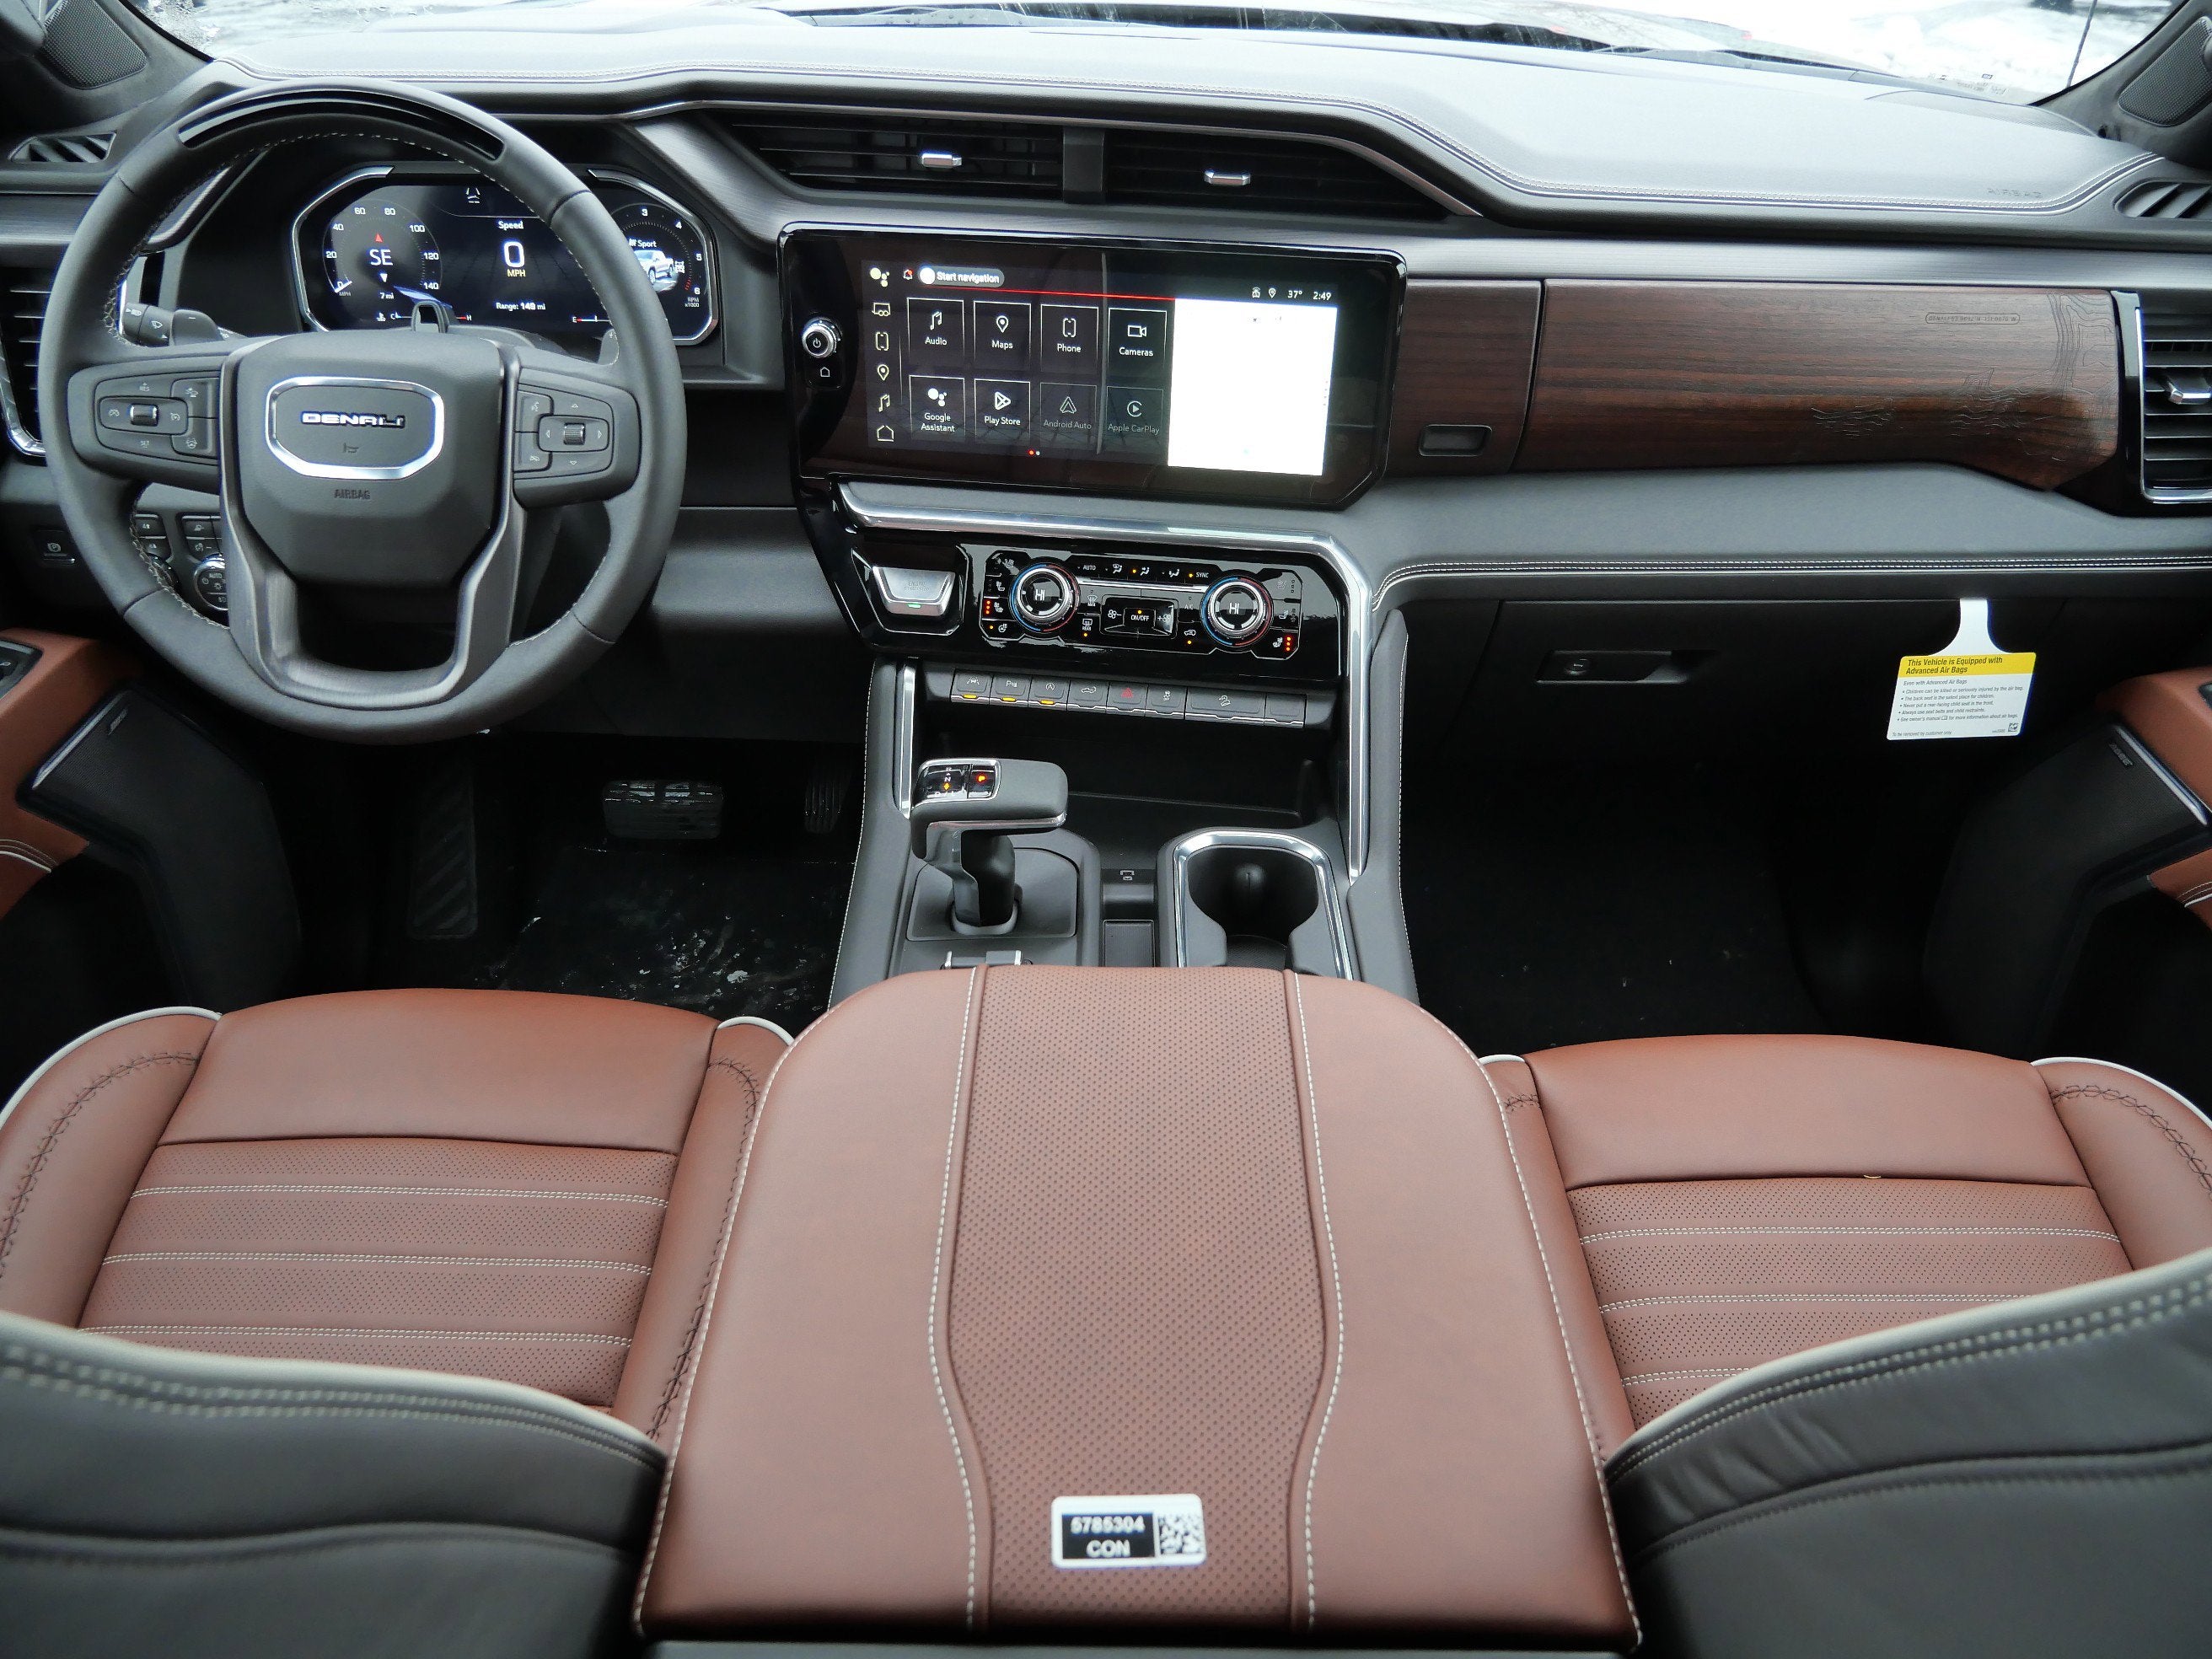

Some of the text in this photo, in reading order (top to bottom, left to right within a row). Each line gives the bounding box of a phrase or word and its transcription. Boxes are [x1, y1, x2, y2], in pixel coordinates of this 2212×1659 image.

[498, 221, 523, 230] Speed
[637, 240, 657, 249] Sport
[369, 249, 393, 266] SE
[504, 241, 524, 267] 0
[696, 253, 702, 261] 5
[507, 269, 526, 277] MPH
[937, 271, 1000, 285] Start navigation
[1287, 290, 1331, 300] 37° 2:49
[496, 303, 519, 311] Range:
[925, 336, 947, 346] Audio
[991, 340, 1013, 351] Maps
[1057, 343, 1082, 353] Phone
[1119, 347, 1154, 357] Cameras
[302, 412, 405, 427] DENALI
[924, 412, 951, 422] Google
[985, 416, 1021, 426] Play Store
[921, 423, 955, 432] Assistant
[1044, 420, 1092, 430] Android Auto
[1108, 423, 1160, 436] Apple CarPlay
[334, 489, 371, 499] AIRBAG
[1034, 589, 1045, 601] HI
[1229, 603, 1239, 615] HI
[1957, 658, 1986, 666] Equipped
[1087, 1539, 1130, 1558] CON
